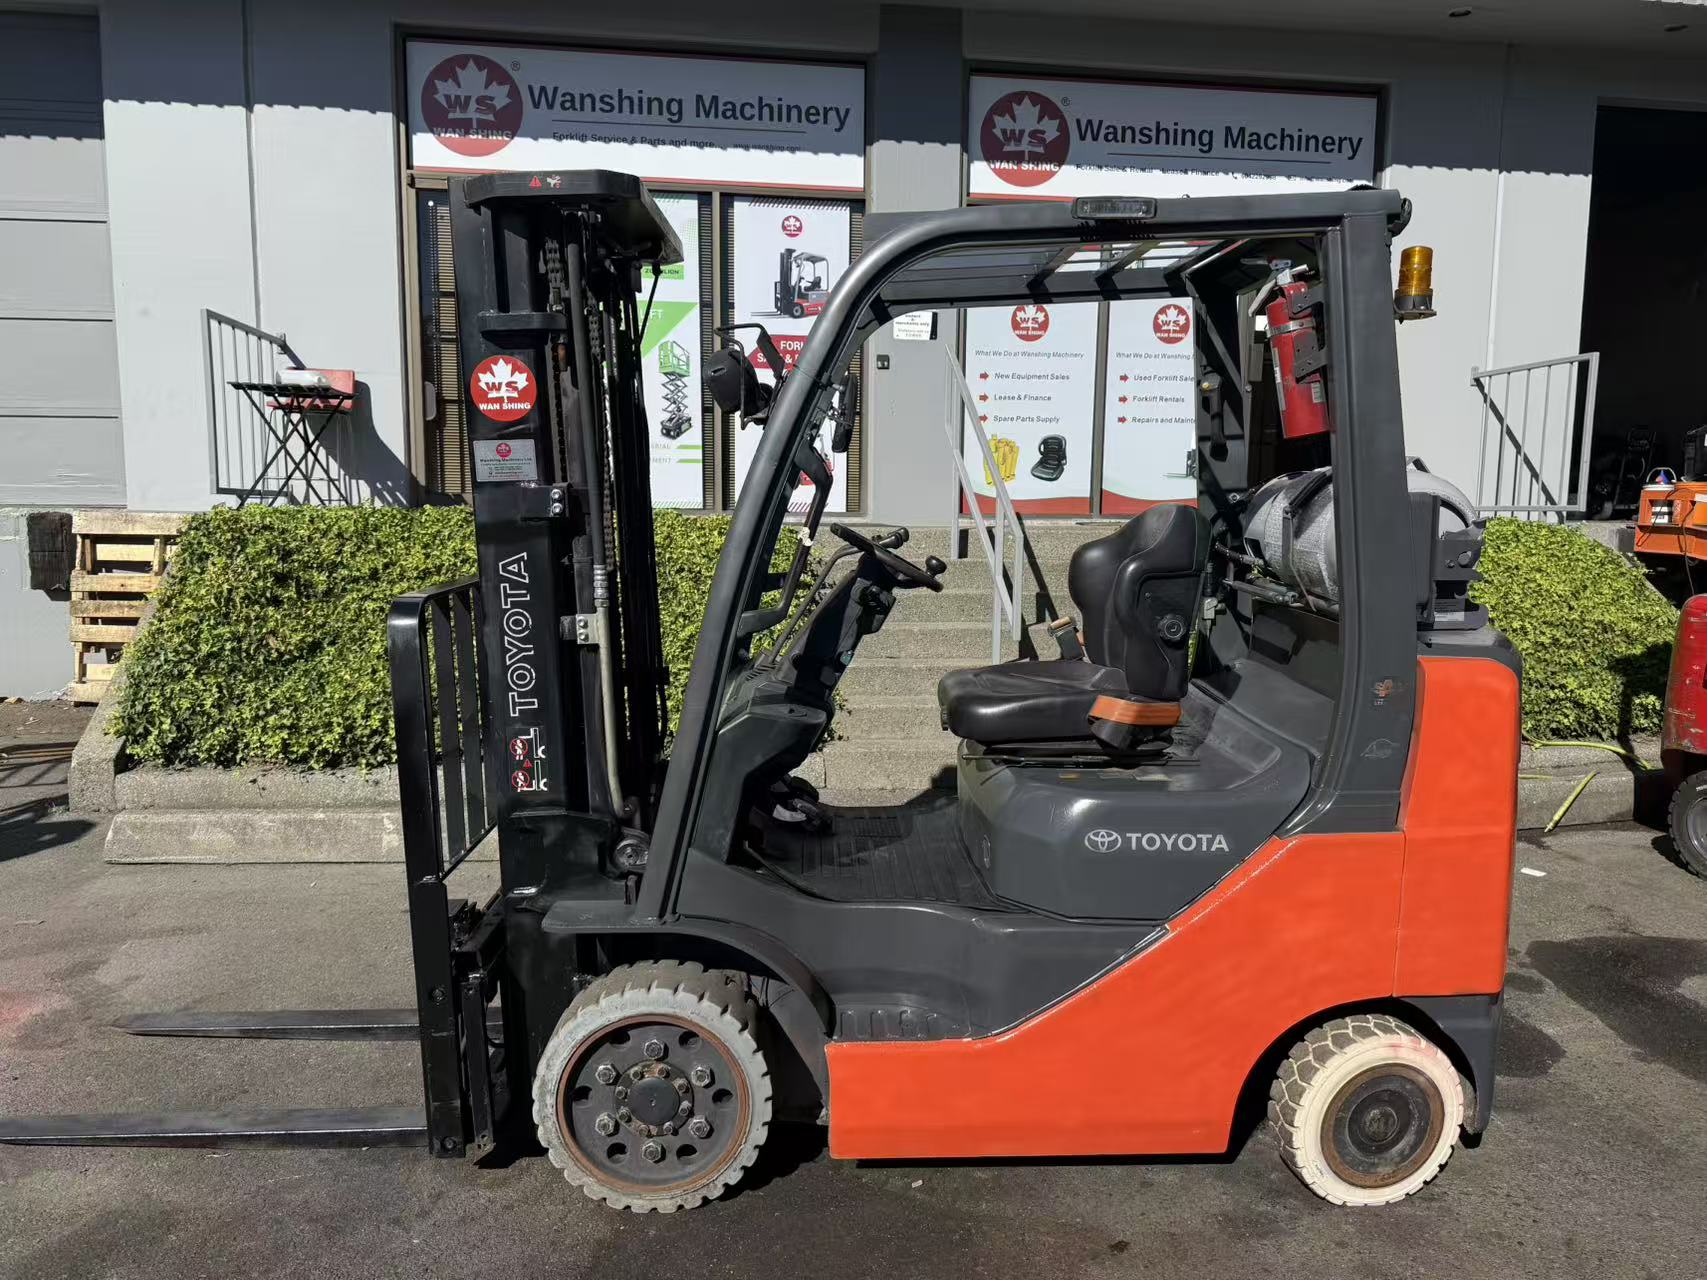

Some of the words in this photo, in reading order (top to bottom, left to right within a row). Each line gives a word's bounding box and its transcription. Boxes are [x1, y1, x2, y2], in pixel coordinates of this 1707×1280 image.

[528, 83, 683, 125] Wanshing
[695, 94, 851, 132] Machinery
[433, 127, 464, 138] WAN
[468, 128, 512, 141] SHING
[552, 132, 587, 143] Forklift
[591, 134, 628, 144] Service
[630, 136, 638, 145] &
[641, 136, 667, 147] Parts
[669, 138, 687, 148] and
[1075, 118, 1214, 153] Wanshing
[1224, 125, 1363, 160] Machinery
[990, 160, 1017, 170] WAN
[1021, 161, 1060, 172] SHING
[785, 353, 793, 364] &
[1021, 351, 1051, 359] Wanshing
[1161, 353, 1190, 361] Wanshing
[1011, 373, 1049, 382] Equipment
[485, 381, 519, 393] WS
[479, 403, 500, 411] WAN
[502, 402, 532, 411] SHING
[993, 415, 1014, 423] Spare
[1036, 415, 1060, 424] Supply
[1131, 416, 1158, 424] Repairs
[499, 551, 539, 717] TOYOTA
[1126, 832, 1230, 852] TOYOTA
